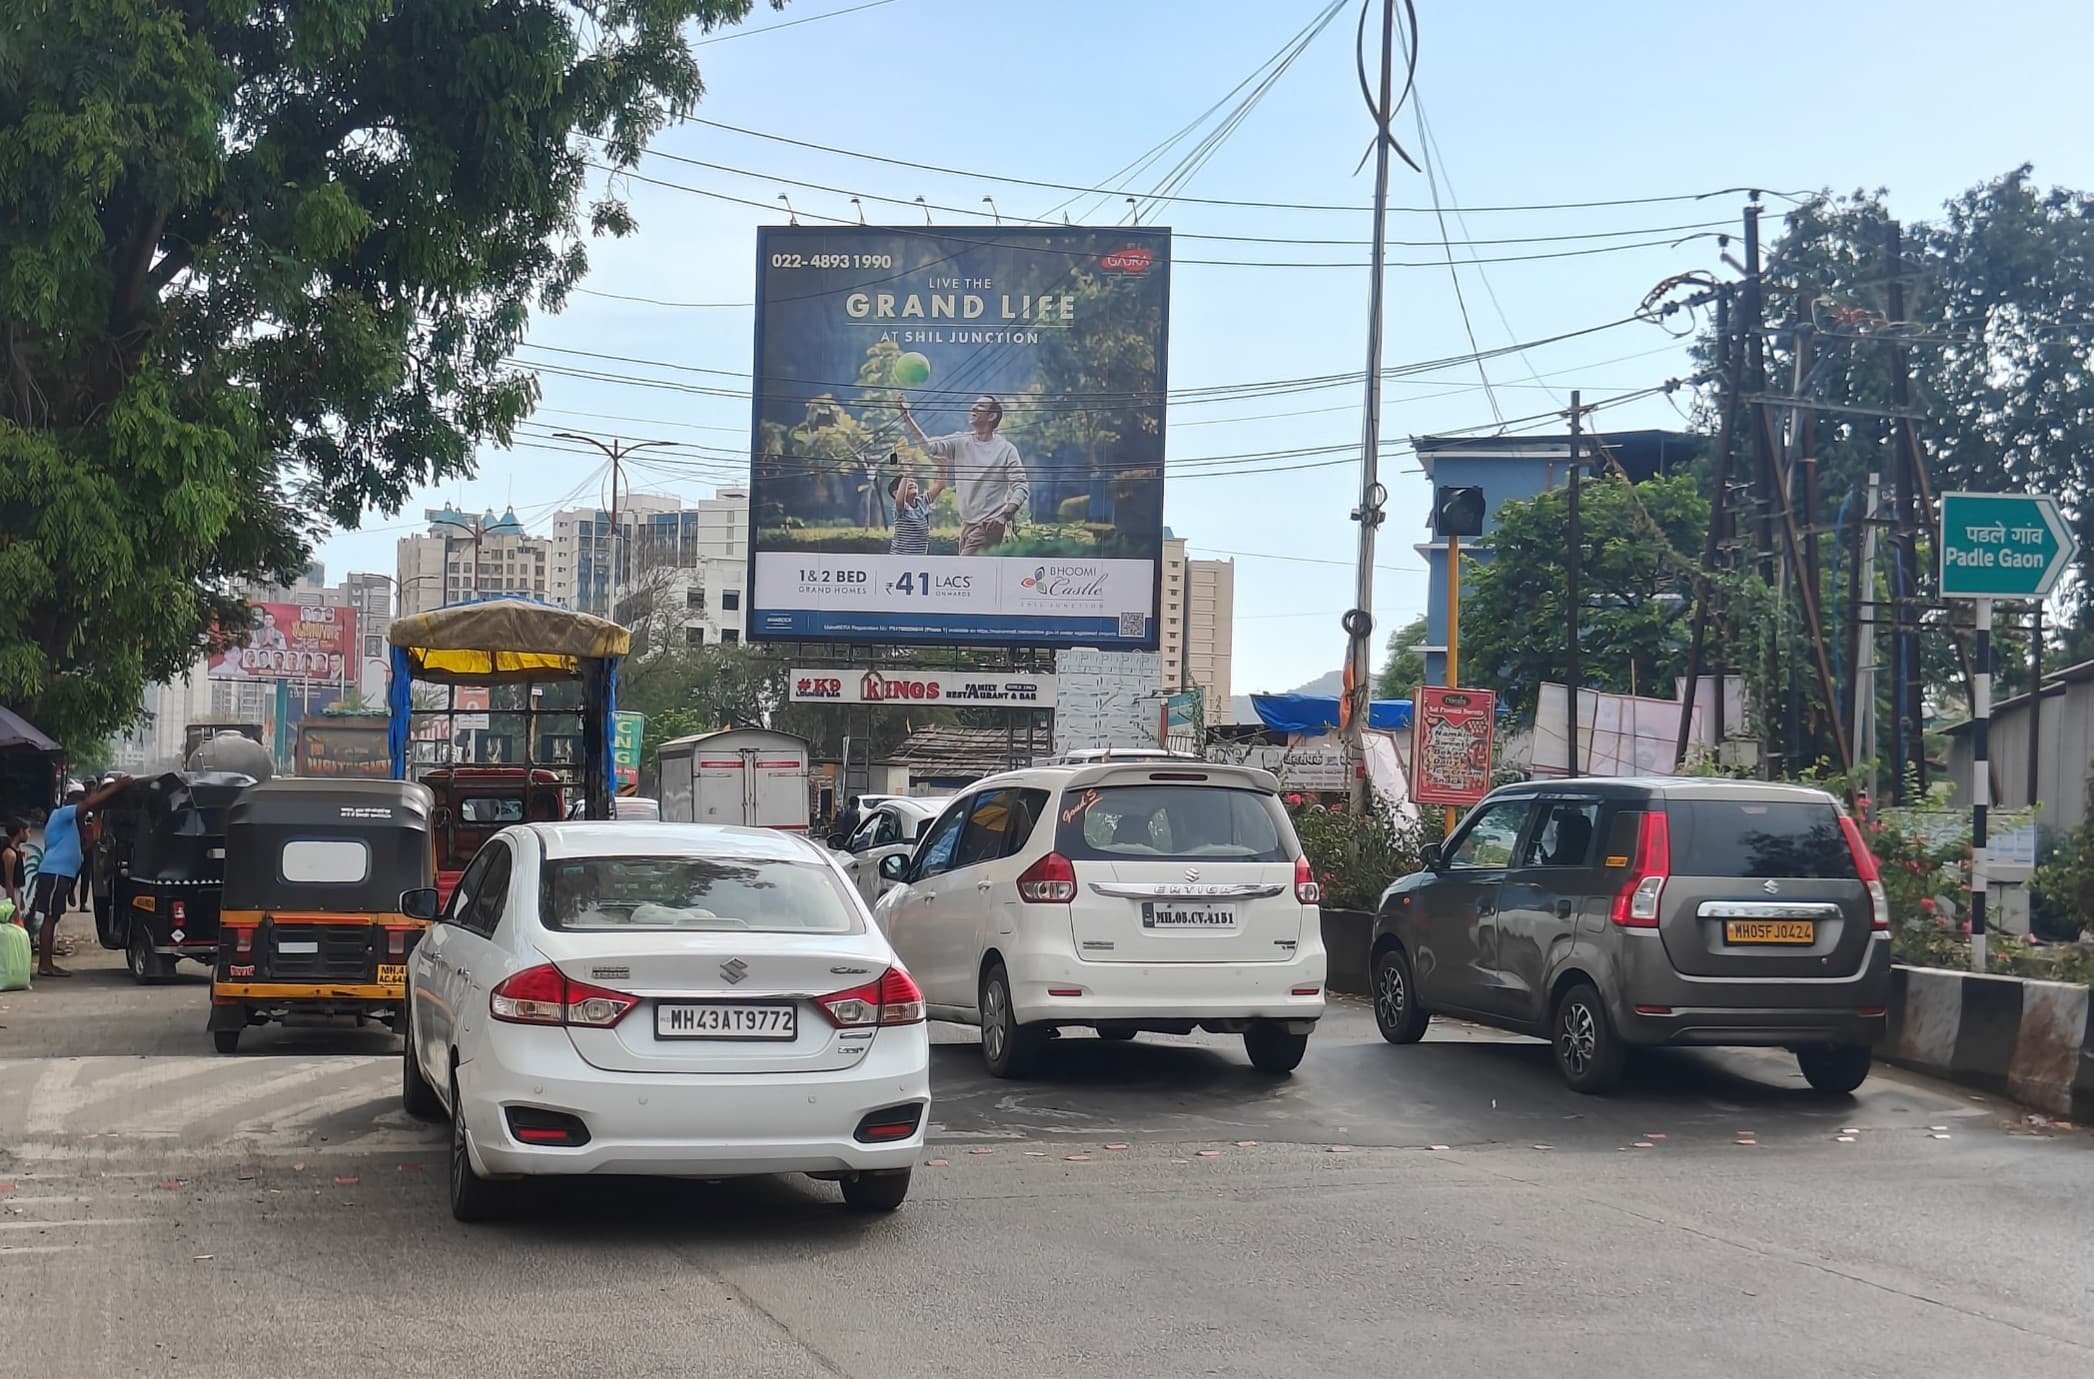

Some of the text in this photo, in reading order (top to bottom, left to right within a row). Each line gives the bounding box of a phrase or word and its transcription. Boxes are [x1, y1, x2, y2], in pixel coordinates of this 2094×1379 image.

[853, 254, 892, 269] 1990
[928, 278, 993, 290] LIVE THE
[845, 293, 1075, 320] GRAND LIFE
[880, 330, 1039, 345] AT SHIL JUNCTION
[1965, 520, 2045, 545] पडले गांव
[1945, 547, 2044, 568] Padle Gaon
[821, 570, 831, 583] 2
[836, 570, 867, 583] BED
[1049, 566, 1097, 577] BHOOMI
[798, 586, 868, 595] GRAND HOMES
[945, 690, 1009, 700] RESTAURANT
[1019, 692, 1037, 701] BAR
[614, 721, 634, 764] CNG
[381, 964, 408, 975] MH.4
[379, 974, 407, 983] AC.64
[670, 1009, 794, 1032] MH43AT9772
